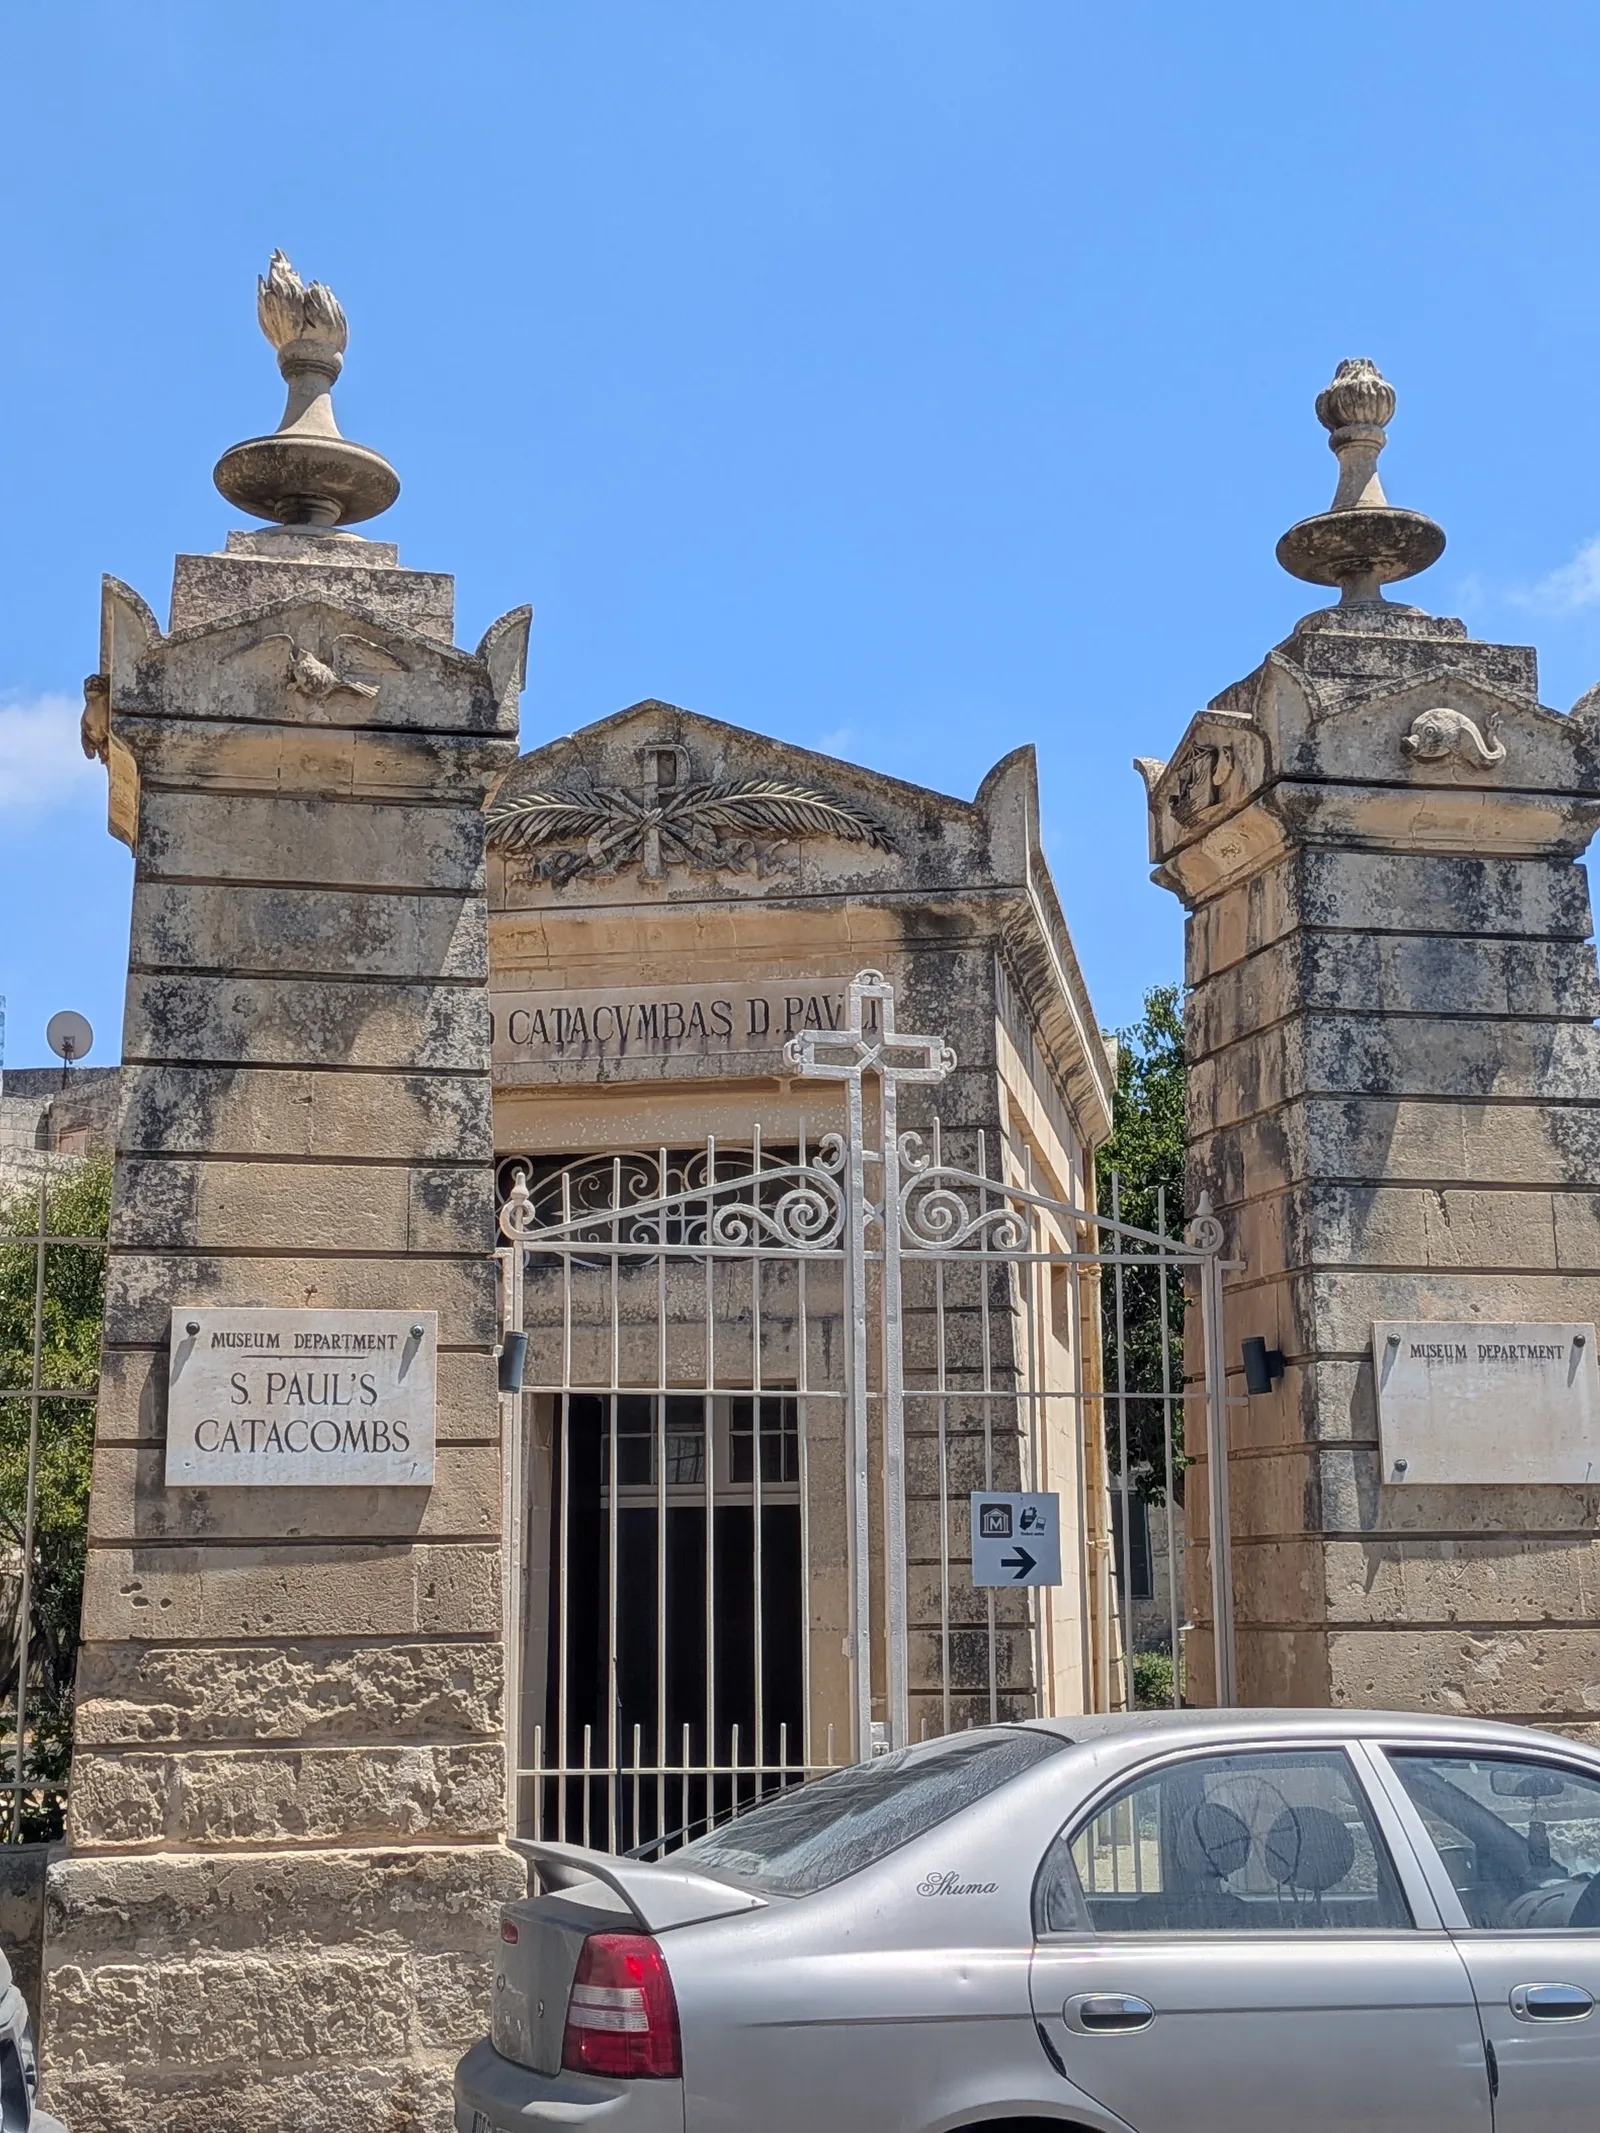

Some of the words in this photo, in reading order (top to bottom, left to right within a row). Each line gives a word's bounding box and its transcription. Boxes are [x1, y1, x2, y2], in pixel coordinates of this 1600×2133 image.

[508, 1000, 732, 1046] CATACVMBAS
[783, 994, 879, 1033] PAVI
[211, 1332, 280, 1349] MUSEUM
[294, 1333, 398, 1350] DEPARTMENT
[1410, 1344, 1468, 1359] MUSEUM
[1477, 1344, 1565, 1360] DEPARTMENT
[266, 1372, 378, 1406] PAUL'S
[194, 1419, 410, 1453] CATACOMBS
[989, 1517, 1003, 1531] M
[916, 1870, 999, 1897] Shuma
